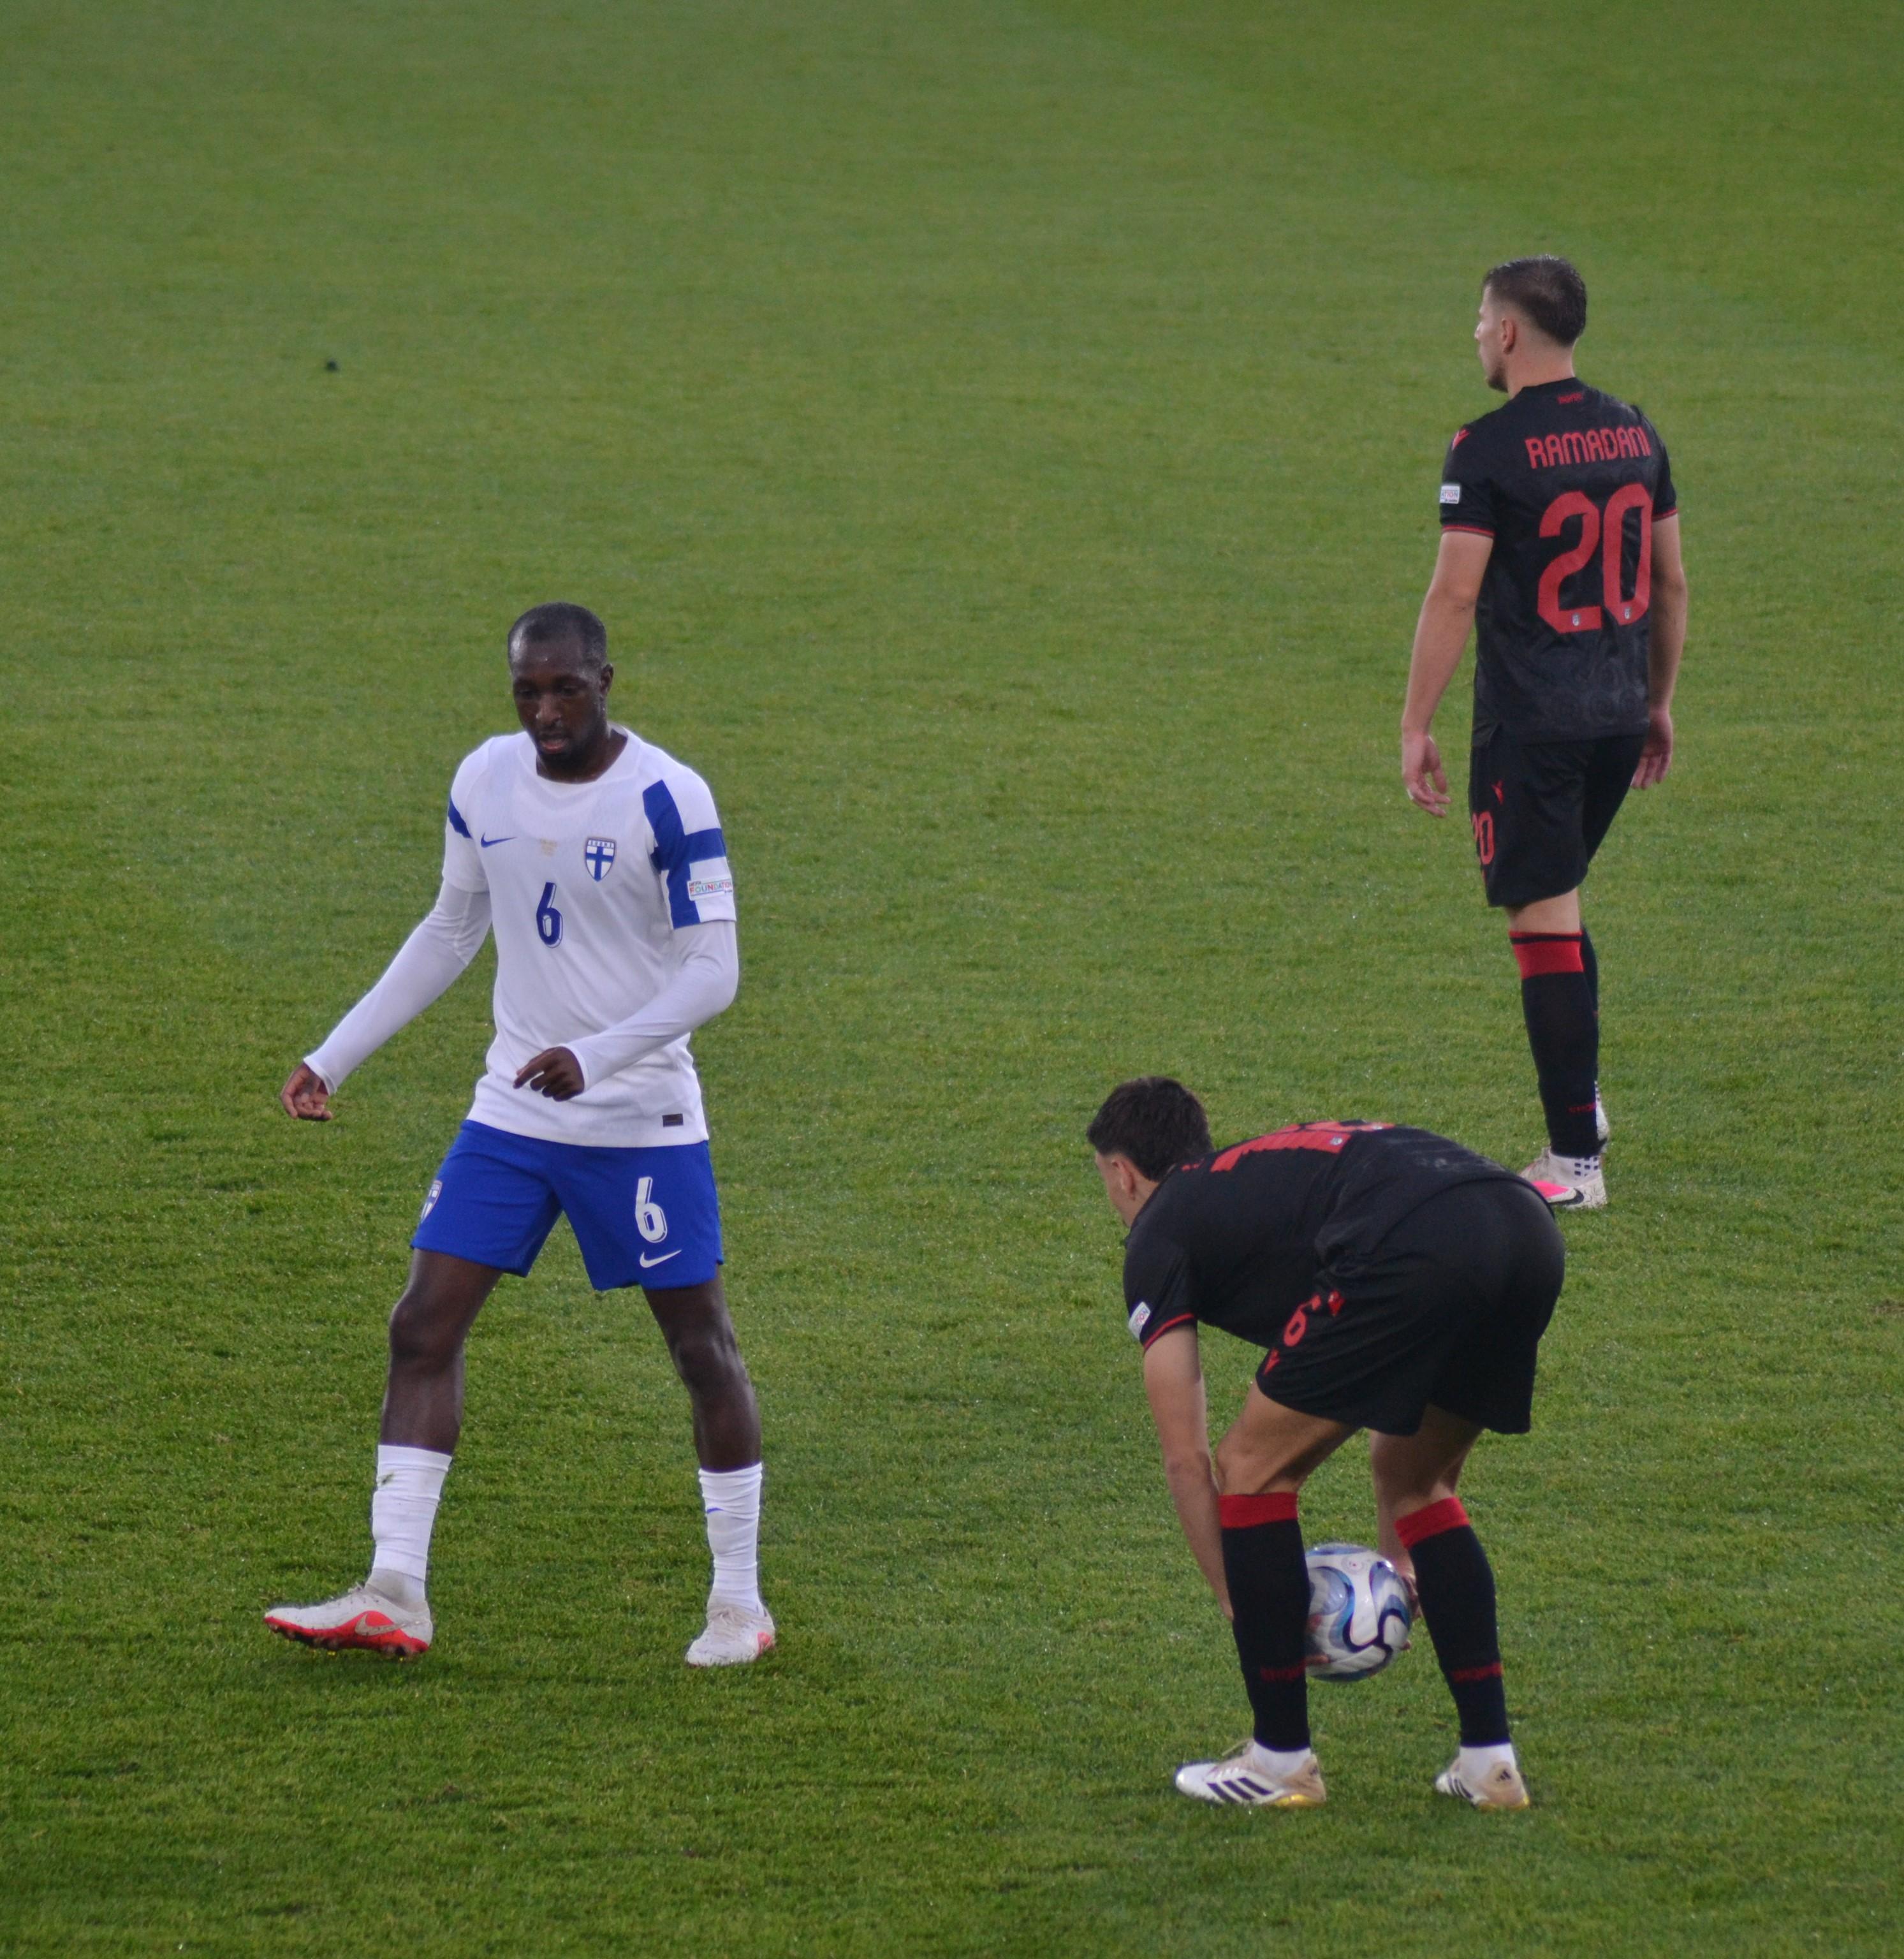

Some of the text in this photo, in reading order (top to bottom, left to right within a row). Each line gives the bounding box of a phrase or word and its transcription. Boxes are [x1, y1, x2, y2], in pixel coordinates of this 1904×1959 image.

[1525, 426, 1652, 469] RAMADANI
[1537, 482, 1653, 633] 20
[536, 882, 563, 948] 6
[635, 1177, 668, 1244] 6
